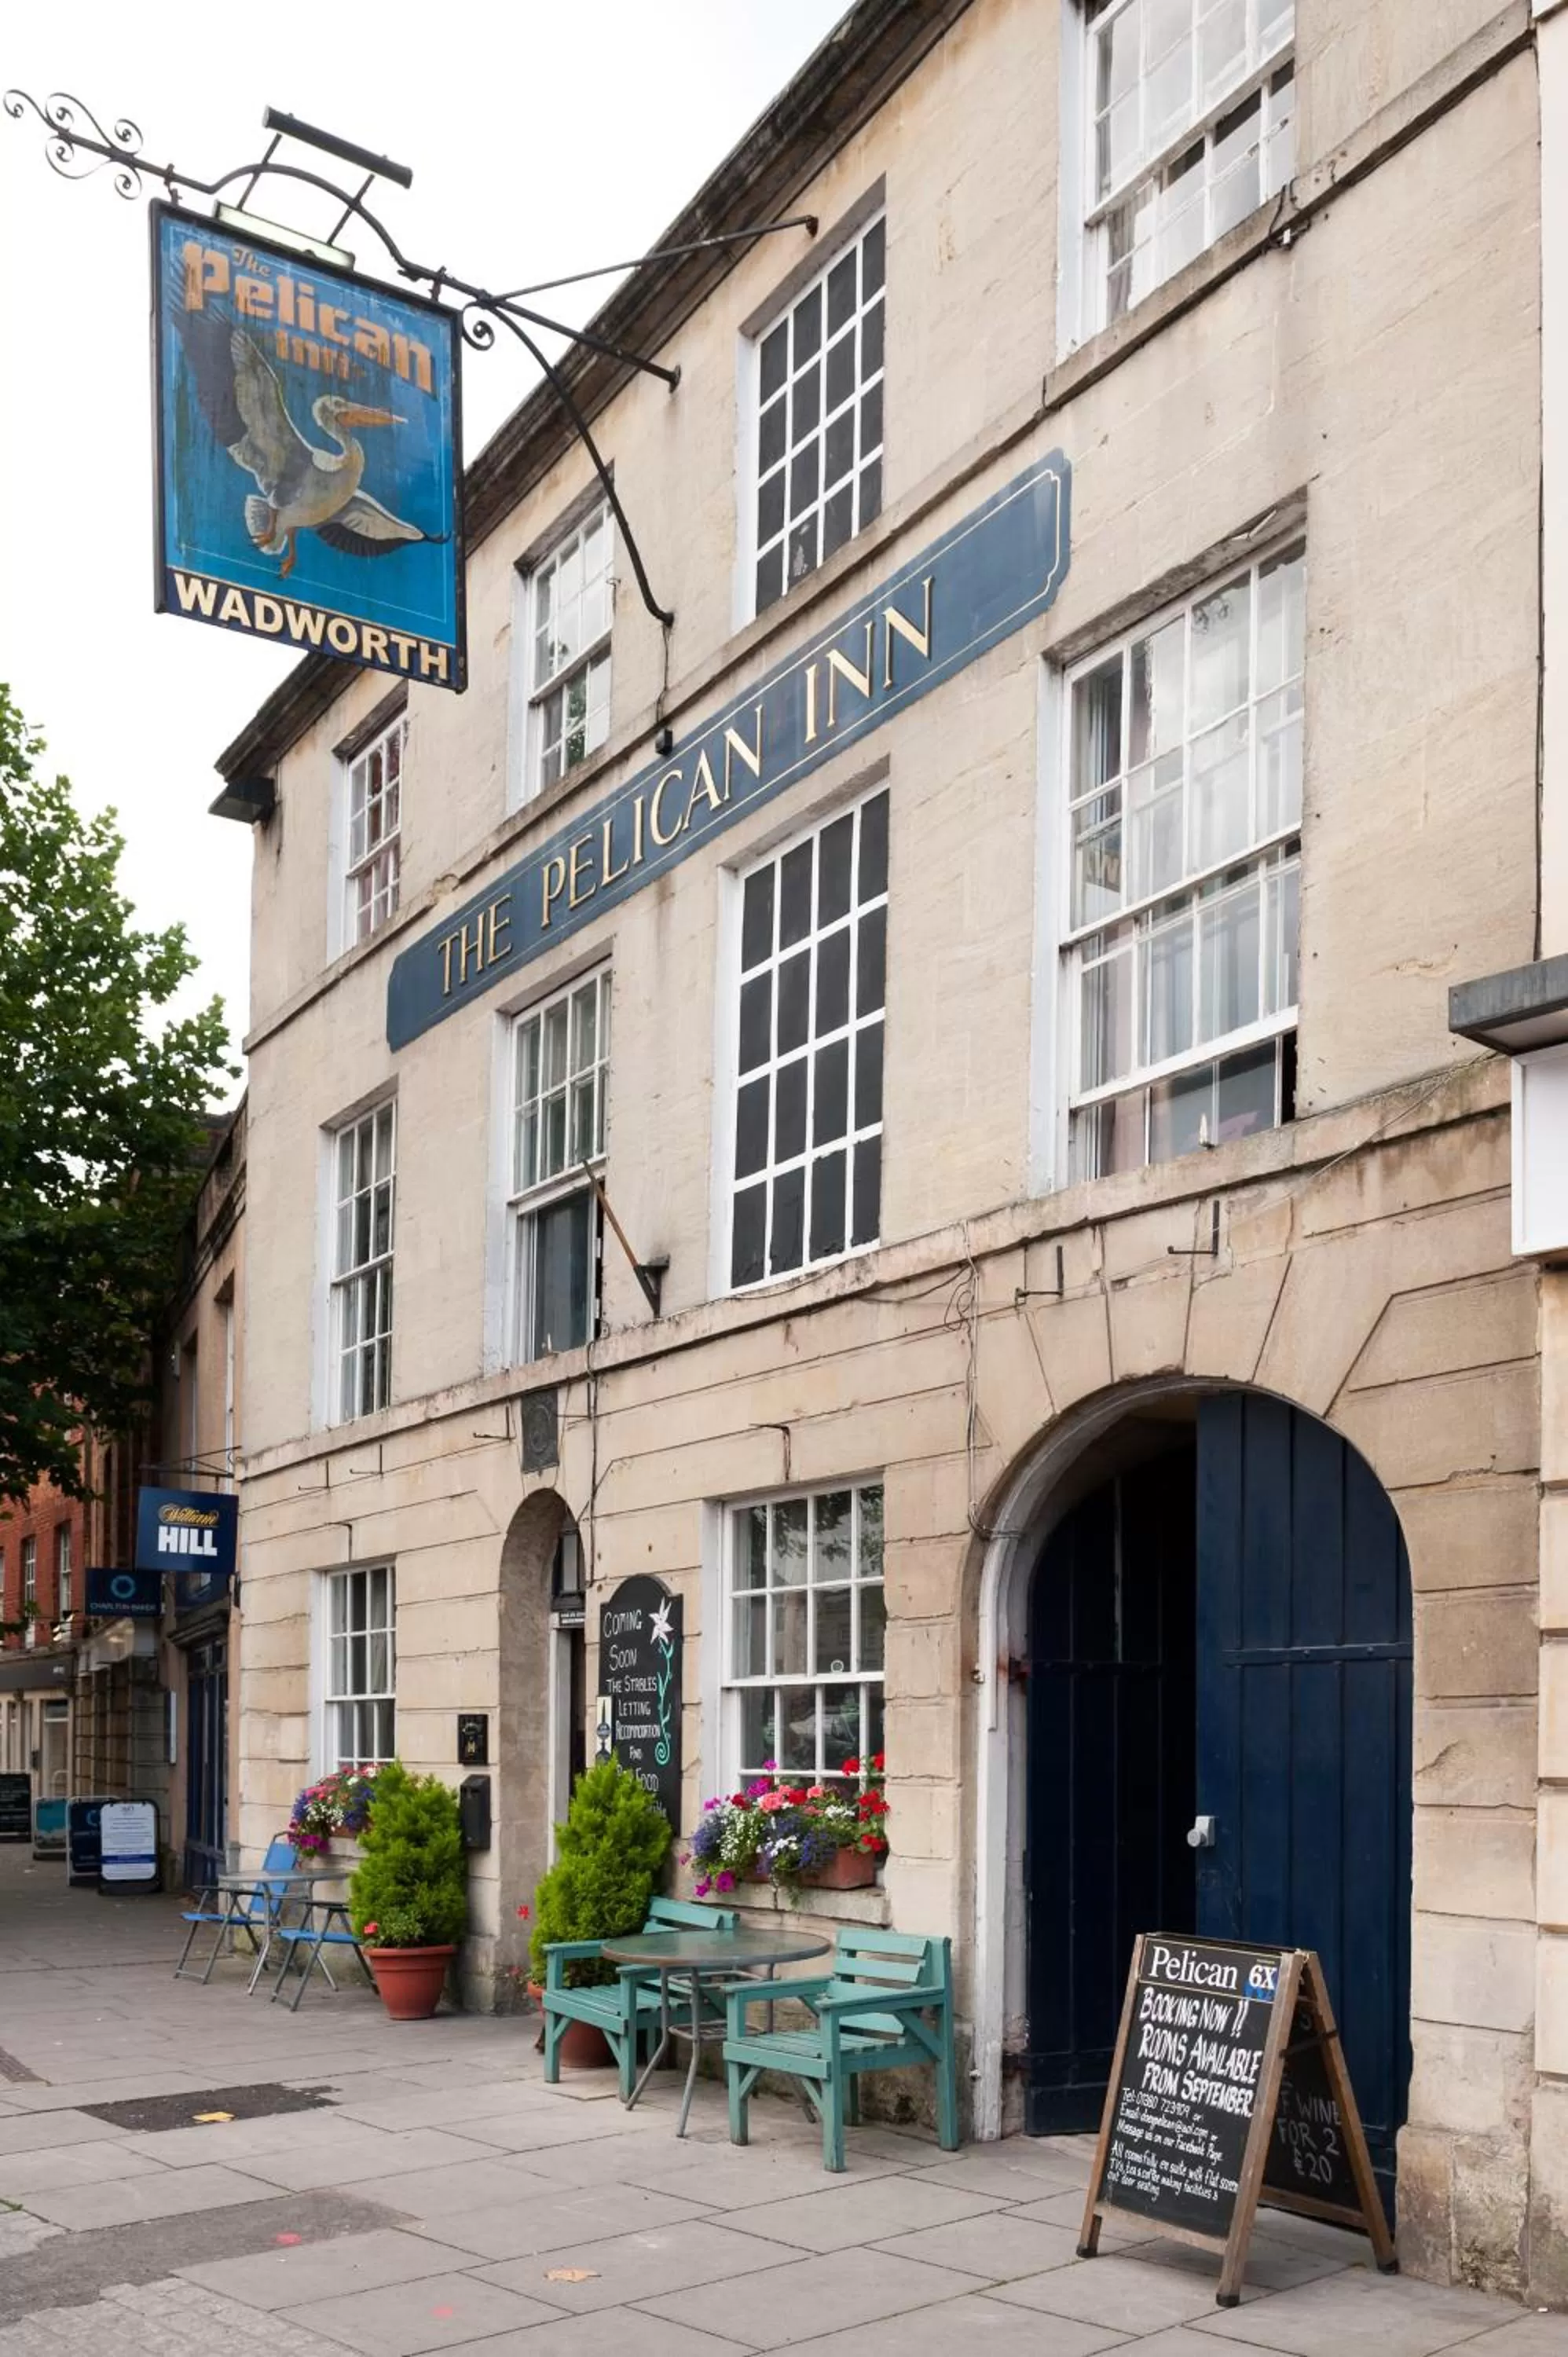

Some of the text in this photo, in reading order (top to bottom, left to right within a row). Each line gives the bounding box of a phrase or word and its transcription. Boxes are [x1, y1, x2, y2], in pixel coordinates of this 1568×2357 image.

[233, 247, 270, 277] The
[184, 240, 432, 394] Pelican
[277, 329, 350, 380] Inn
[173, 573, 449, 680] WADWORTH
[437, 576, 934, 997] THE PELICAN INN
[158, 1503, 220, 1527] William
[158, 1525, 218, 1556] HILL
[603, 1608, 643, 1638] COMING
[609, 1644, 637, 1671] SOON
[606, 1674, 658, 1693] THE STABLES
[617, 1699, 651, 1717] LETTING
[1149, 1945, 1238, 1990] Pelican
[1248, 1964, 1278, 1989] 6X
[1139, 1986, 1200, 2028] BOOKING
[1198, 1997, 1233, 2033] NOW
[1138, 2022, 1263, 2084] ROOMS AVAILABLE
[1141, 2061, 1180, 2097] FROM
[1111, 2139, 1125, 2158] All
[1116, 2117, 1145, 2143] Message
[1175, 2133, 1205, 2157] Facebook
[1277, 2117, 1340, 2156] FOR 2
